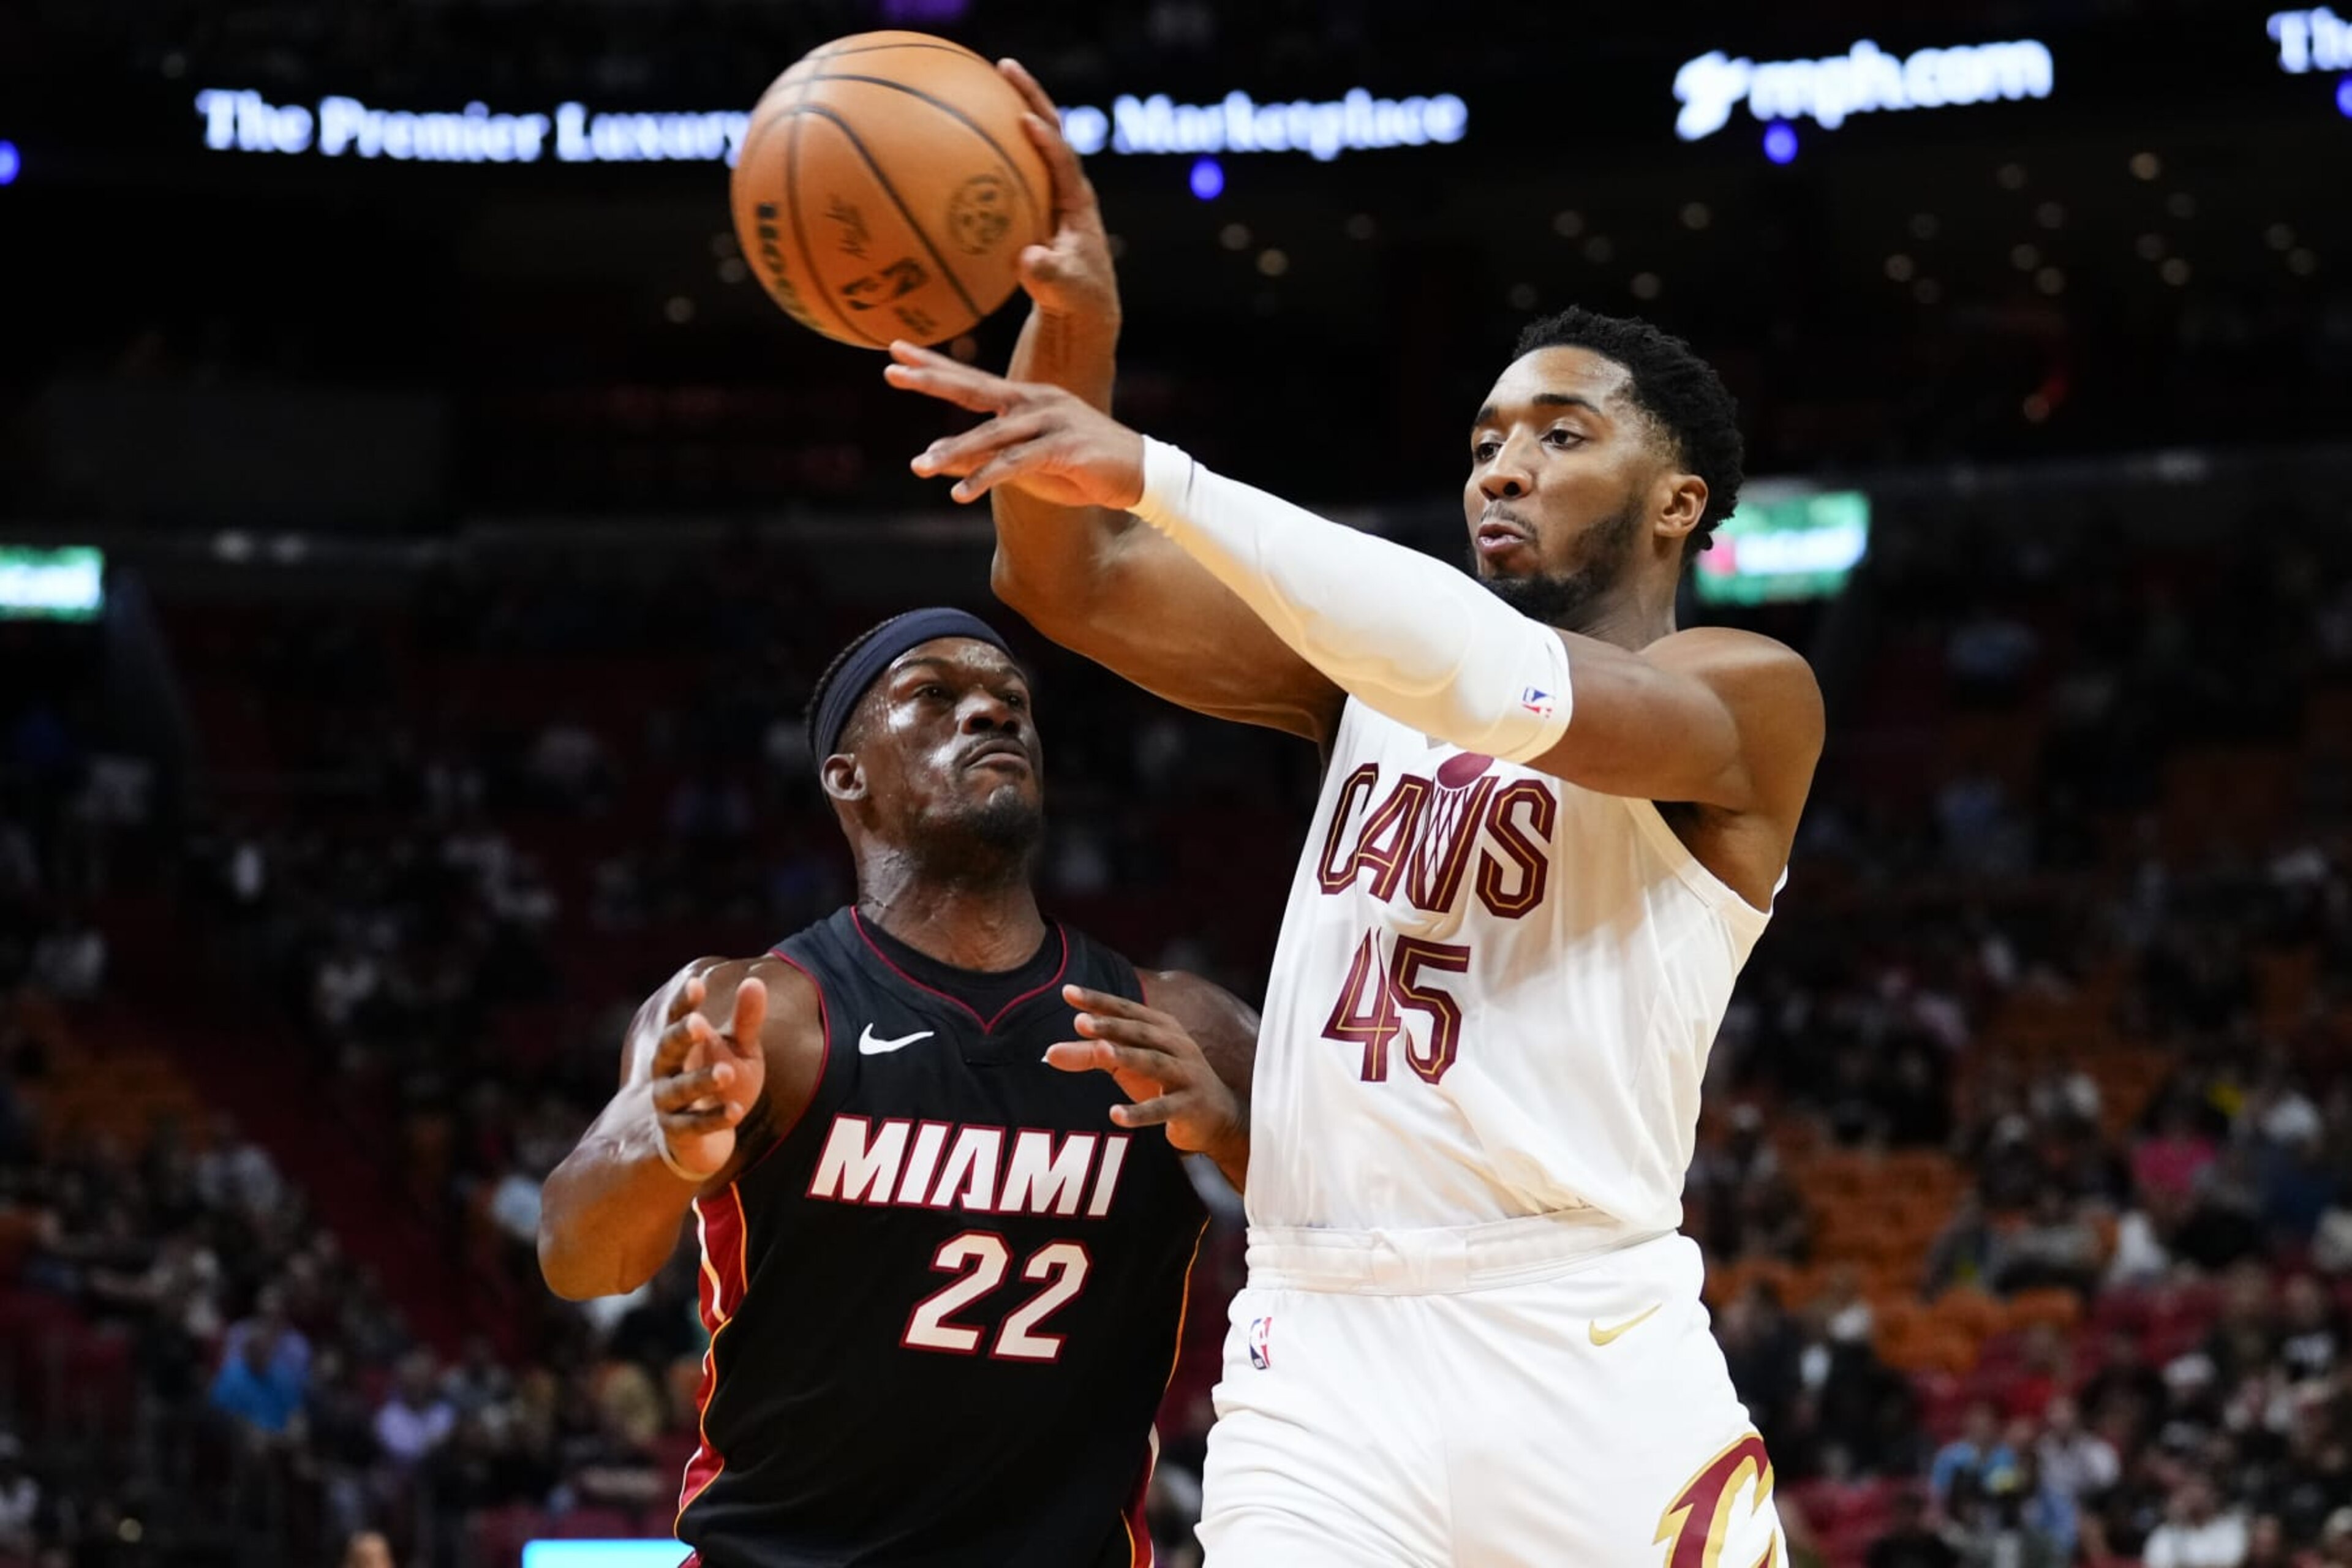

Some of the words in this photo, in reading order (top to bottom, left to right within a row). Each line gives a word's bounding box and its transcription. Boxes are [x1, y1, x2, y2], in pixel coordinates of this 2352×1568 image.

[195, 89, 313, 153] The
[318, 96, 550, 162] Premier
[1111, 88, 1468, 162] Marketplace
[1317, 763, 1557, 919] CAVS
[1321, 926, 1471, 1085] 45
[805, 1112, 1134, 1220] MIAMI
[899, 1229, 1093, 1363] 22
